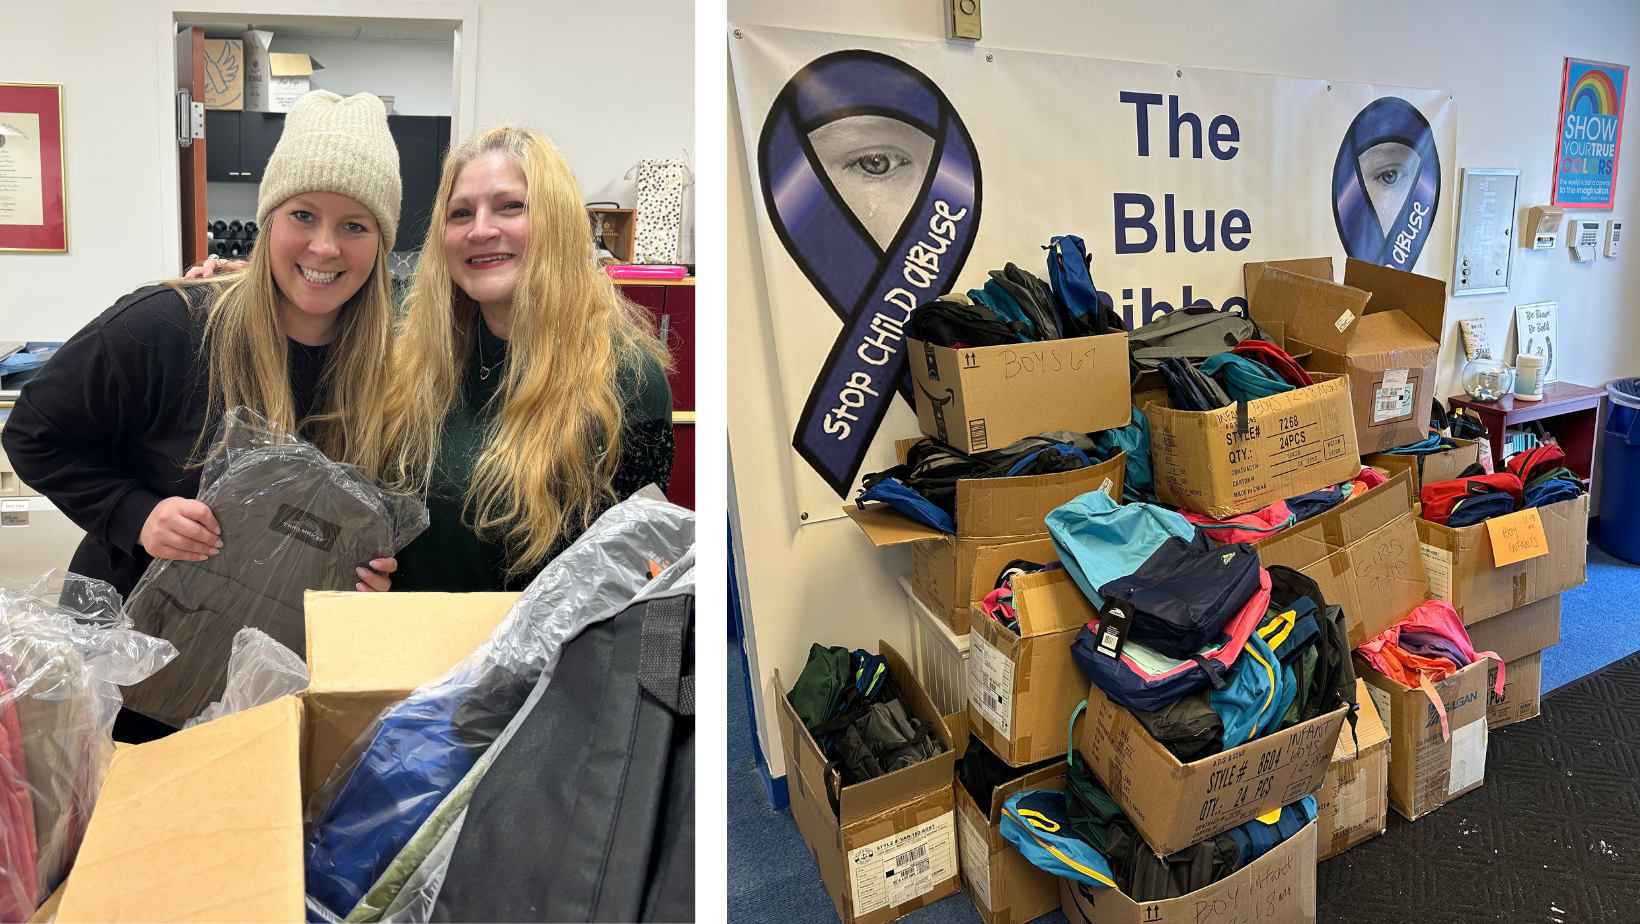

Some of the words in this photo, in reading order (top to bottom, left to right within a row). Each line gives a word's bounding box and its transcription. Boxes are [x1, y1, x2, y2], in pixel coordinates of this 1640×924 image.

[1120, 90, 1240, 160] The
[1565, 114, 1618, 142] SHOW
[1562, 157, 1613, 175] COLORS
[1560, 186, 1566, 194] to
[1567, 186, 1575, 194] the
[1113, 192, 1252, 255] Blue
[1525, 311, 1535, 320] Be
[1528, 324, 1536, 334] Be
[1536, 321, 1550, 333] Bold
[998, 350, 1061, 379] BOYS
[1250, 397, 1281, 417] BOYS
[1279, 415, 1299, 431] 7268
[1253, 483, 1267, 493] CHINA
[1502, 527, 1519, 538] BOY
[1508, 536, 1539, 554] INFANTS
[1286, 719, 1334, 755] INFANT
[1290, 740, 1320, 763] BOYS
[1207, 765, 1236, 794] STYLE
[1236, 760, 1248, 783] #
[1257, 747, 1283, 774] 8604
[1234, 786, 1248, 807] 24
[1254, 775, 1274, 800] PCS
[1193, 885, 1239, 924] BOY
